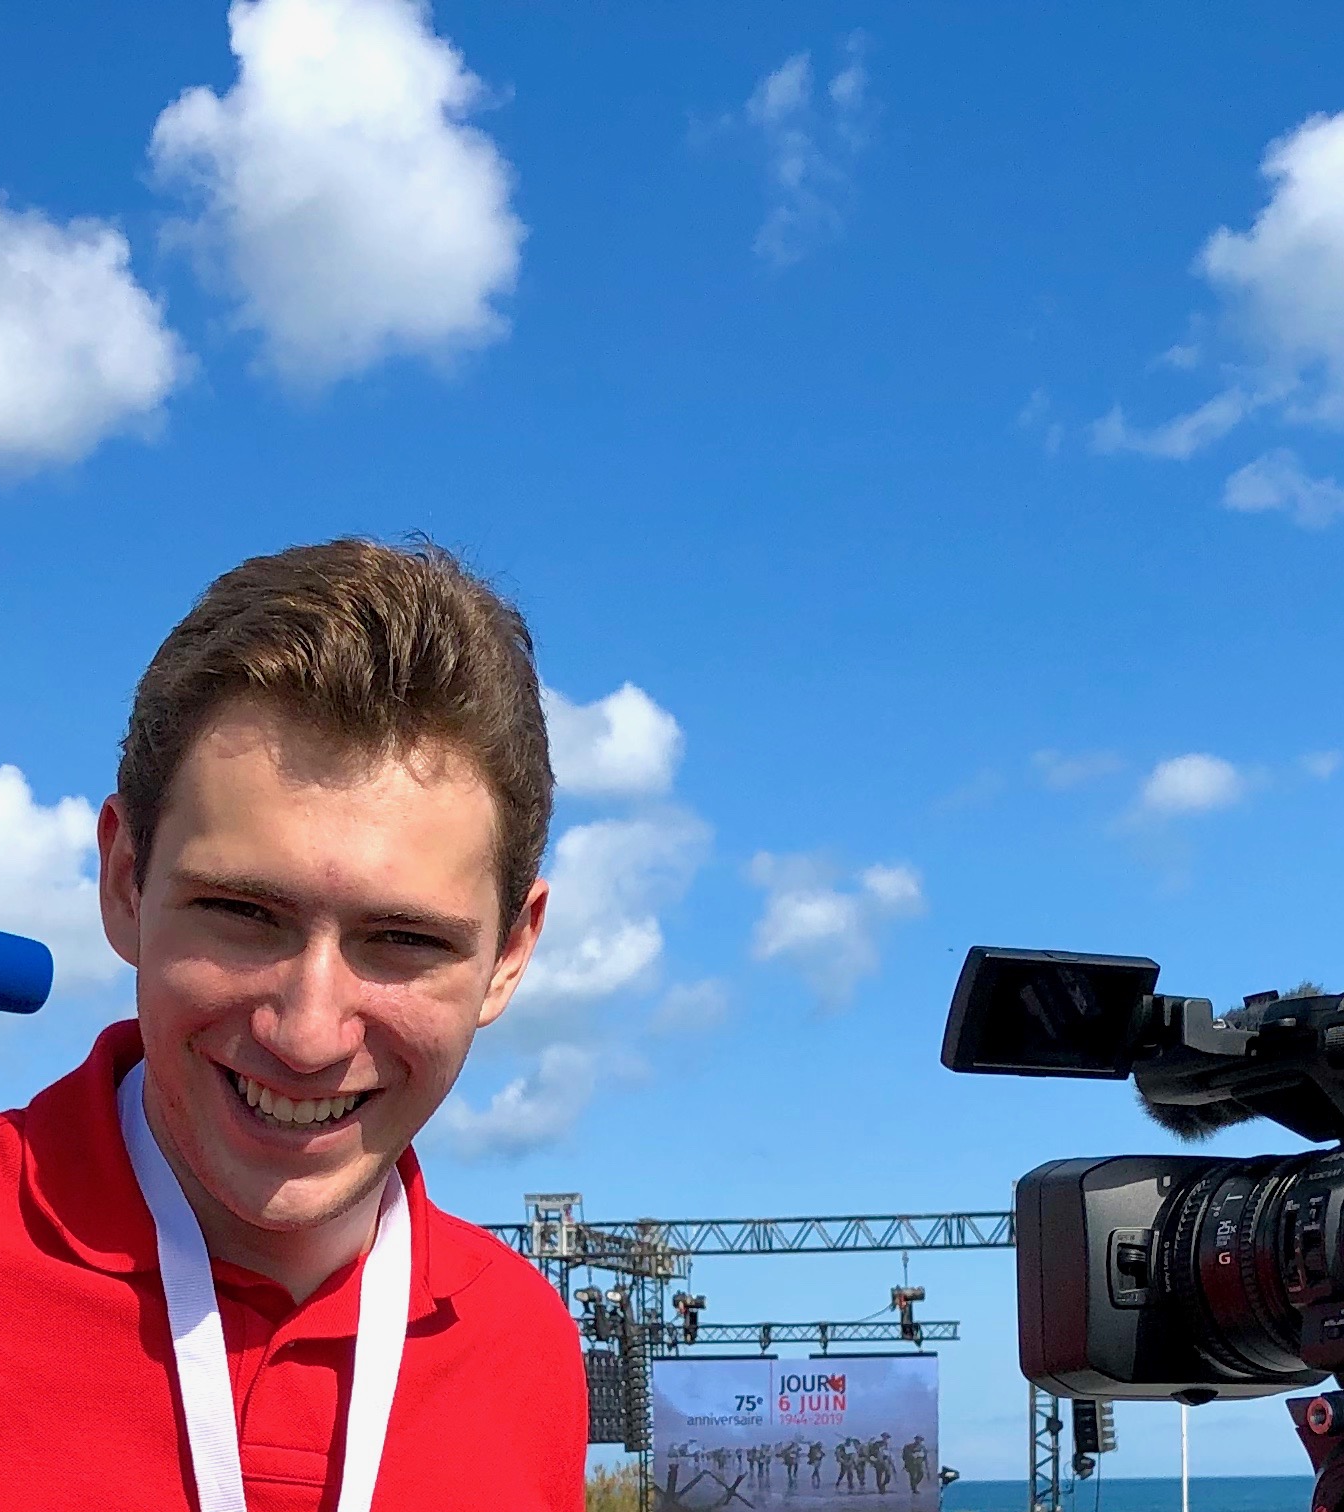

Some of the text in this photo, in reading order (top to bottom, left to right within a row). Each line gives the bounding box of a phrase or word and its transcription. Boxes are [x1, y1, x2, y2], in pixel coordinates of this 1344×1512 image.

[1218, 1251, 1231, 1265] G
[778, 1374, 829, 1395] JOUR
[778, 1394, 846, 1414] 6 JUIN
[687, 1412, 763, 1426] anniversaire
